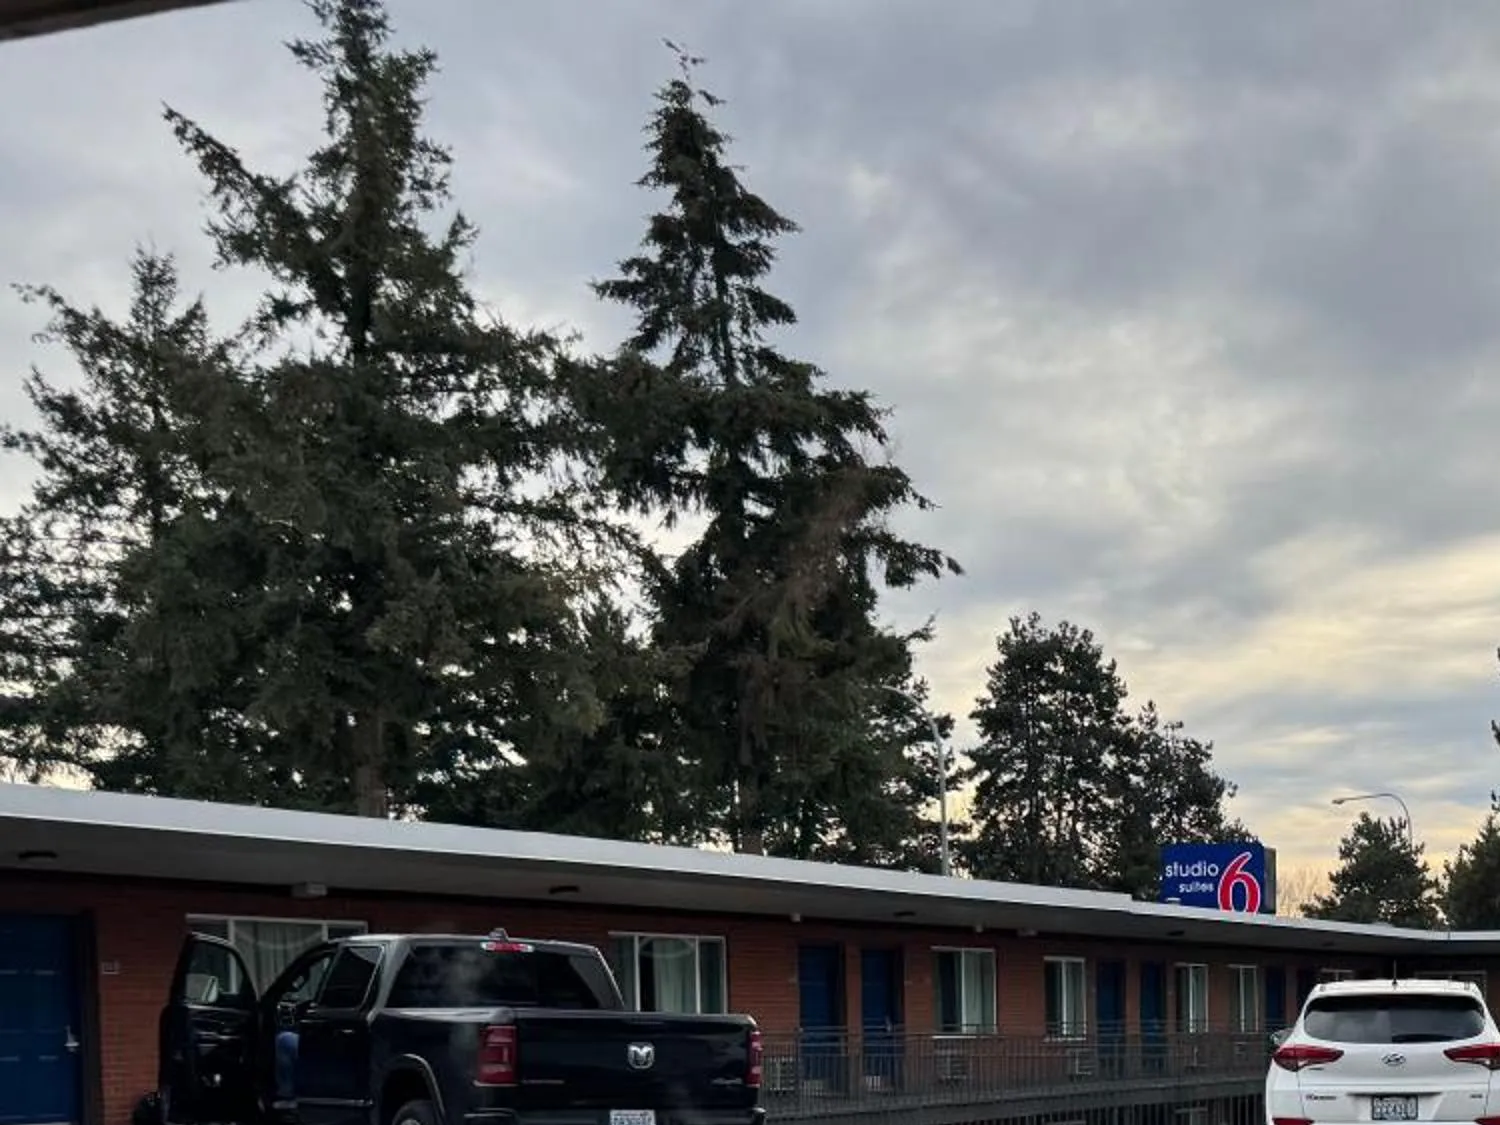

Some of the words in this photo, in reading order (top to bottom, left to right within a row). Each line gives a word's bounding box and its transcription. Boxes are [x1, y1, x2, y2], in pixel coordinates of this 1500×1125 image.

[1165, 860, 1219, 877] studio
[1217, 851, 1261, 914] 6
[1179, 881, 1214, 893] suites
